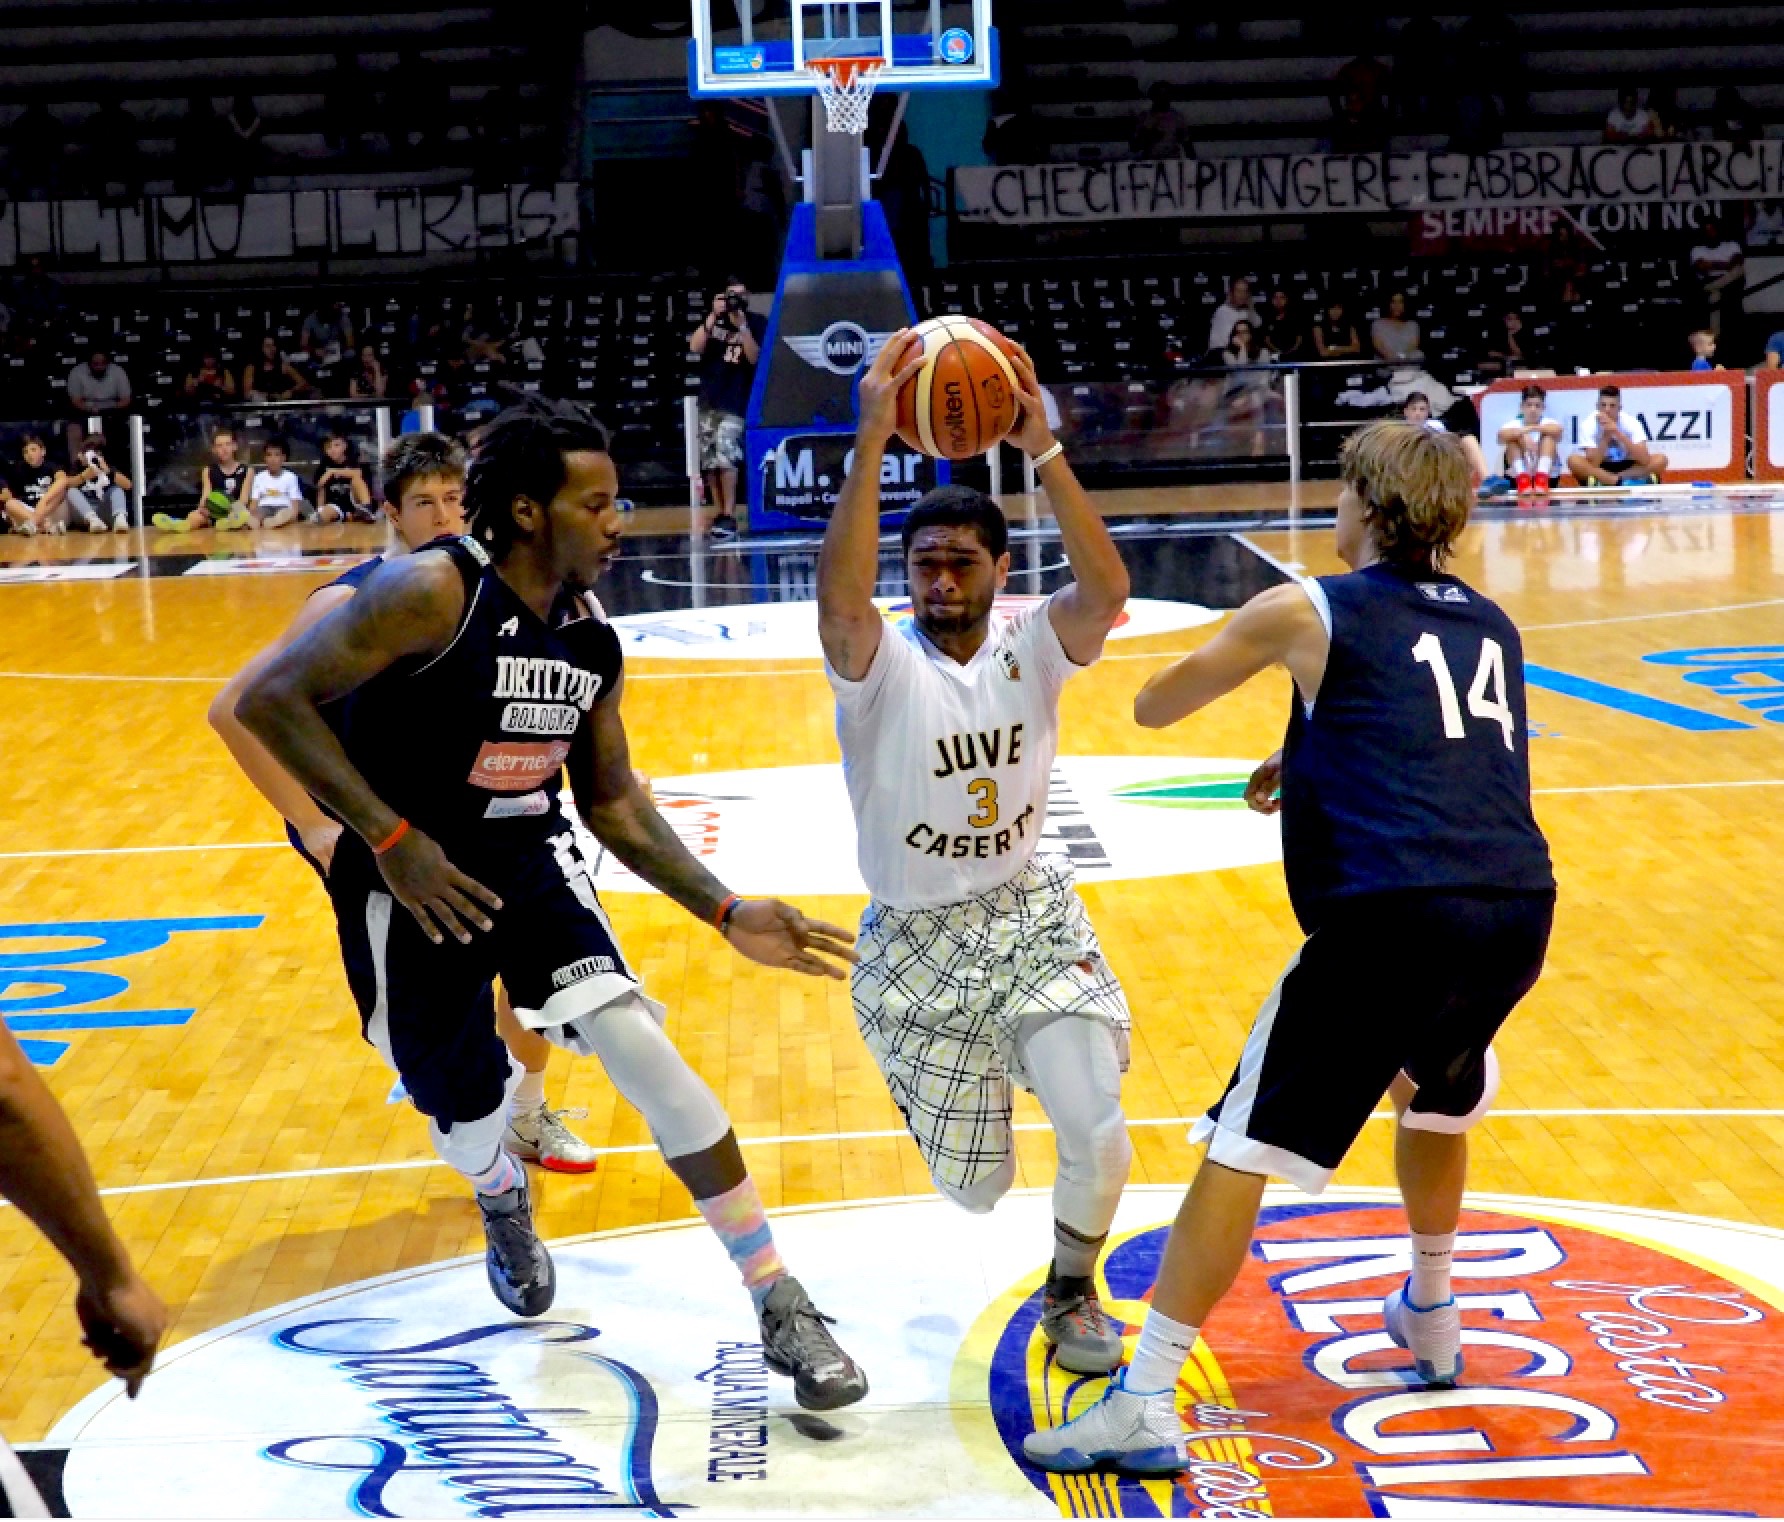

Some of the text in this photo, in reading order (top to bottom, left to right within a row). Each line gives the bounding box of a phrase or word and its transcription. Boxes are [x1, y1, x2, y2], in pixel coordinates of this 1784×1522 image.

[1580, 202, 1649, 232] CON
[827, 341, 863, 356] MINI
[945, 381, 967, 452] molten
[508, 706, 575, 731] BOLOGNA
[1411, 632, 1515, 752] 14
[933, 723, 1023, 778] JUVE
[966, 777, 999, 828] 3
[1251, 1227, 1757, 1518] REGGI
[1551, 1278, 1765, 1414] Pasta
[707, 1396, 769, 1483] MINERALE
